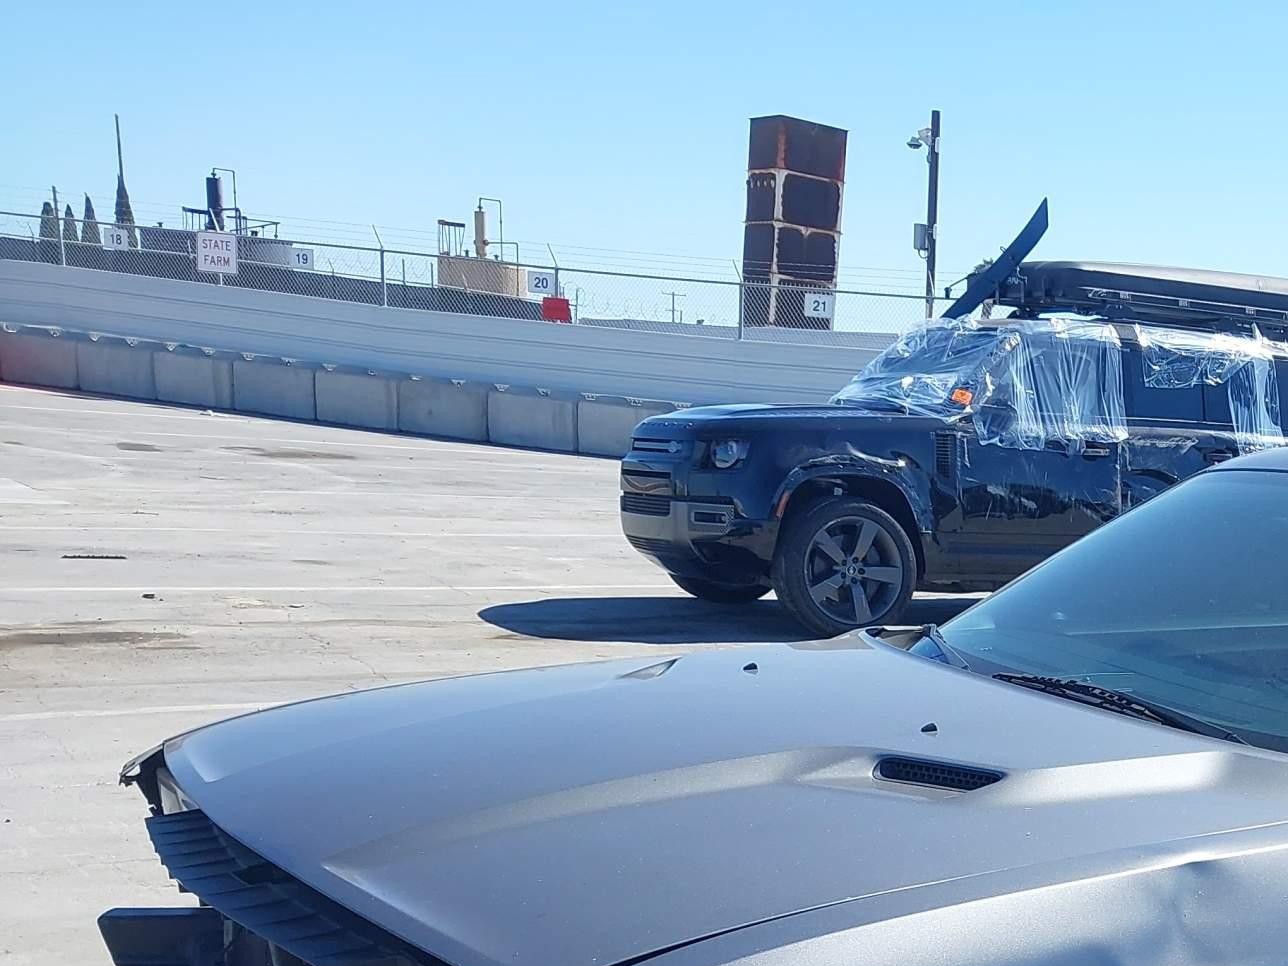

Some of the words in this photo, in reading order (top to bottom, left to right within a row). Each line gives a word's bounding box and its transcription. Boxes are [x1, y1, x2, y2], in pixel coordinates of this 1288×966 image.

[110, 233, 122, 245] 18
[203, 239, 231, 251] STATE
[203, 254, 231, 267] FARM
[296, 253, 308, 265] 19
[534, 276, 549, 290] 20
[812, 299, 828, 313] 21
